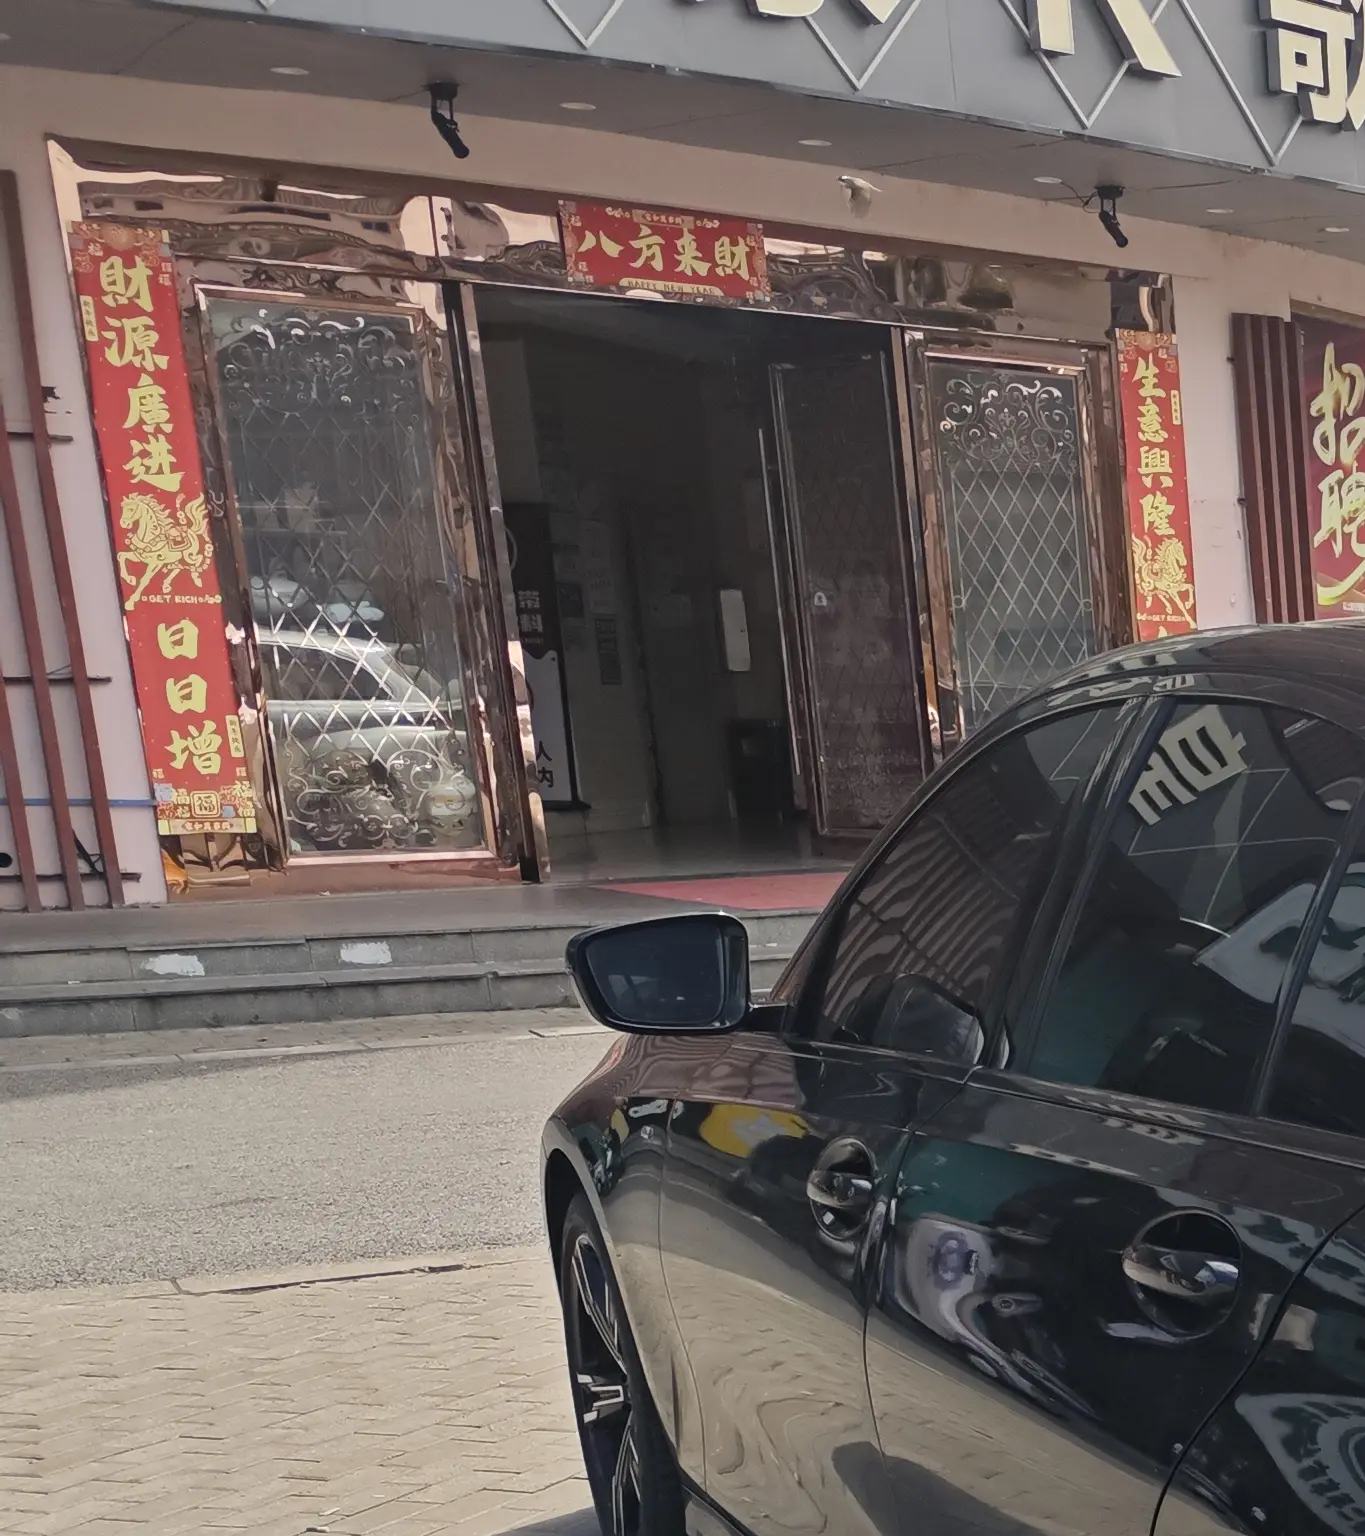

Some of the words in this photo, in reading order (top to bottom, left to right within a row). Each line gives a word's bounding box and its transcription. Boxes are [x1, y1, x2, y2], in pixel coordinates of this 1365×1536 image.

[627, 280, 657, 290] HAPPY
[663, 285, 684, 293] NEW
[1132, 352, 1176, 536] 生意興隆
[150, 594, 171, 603] GET
